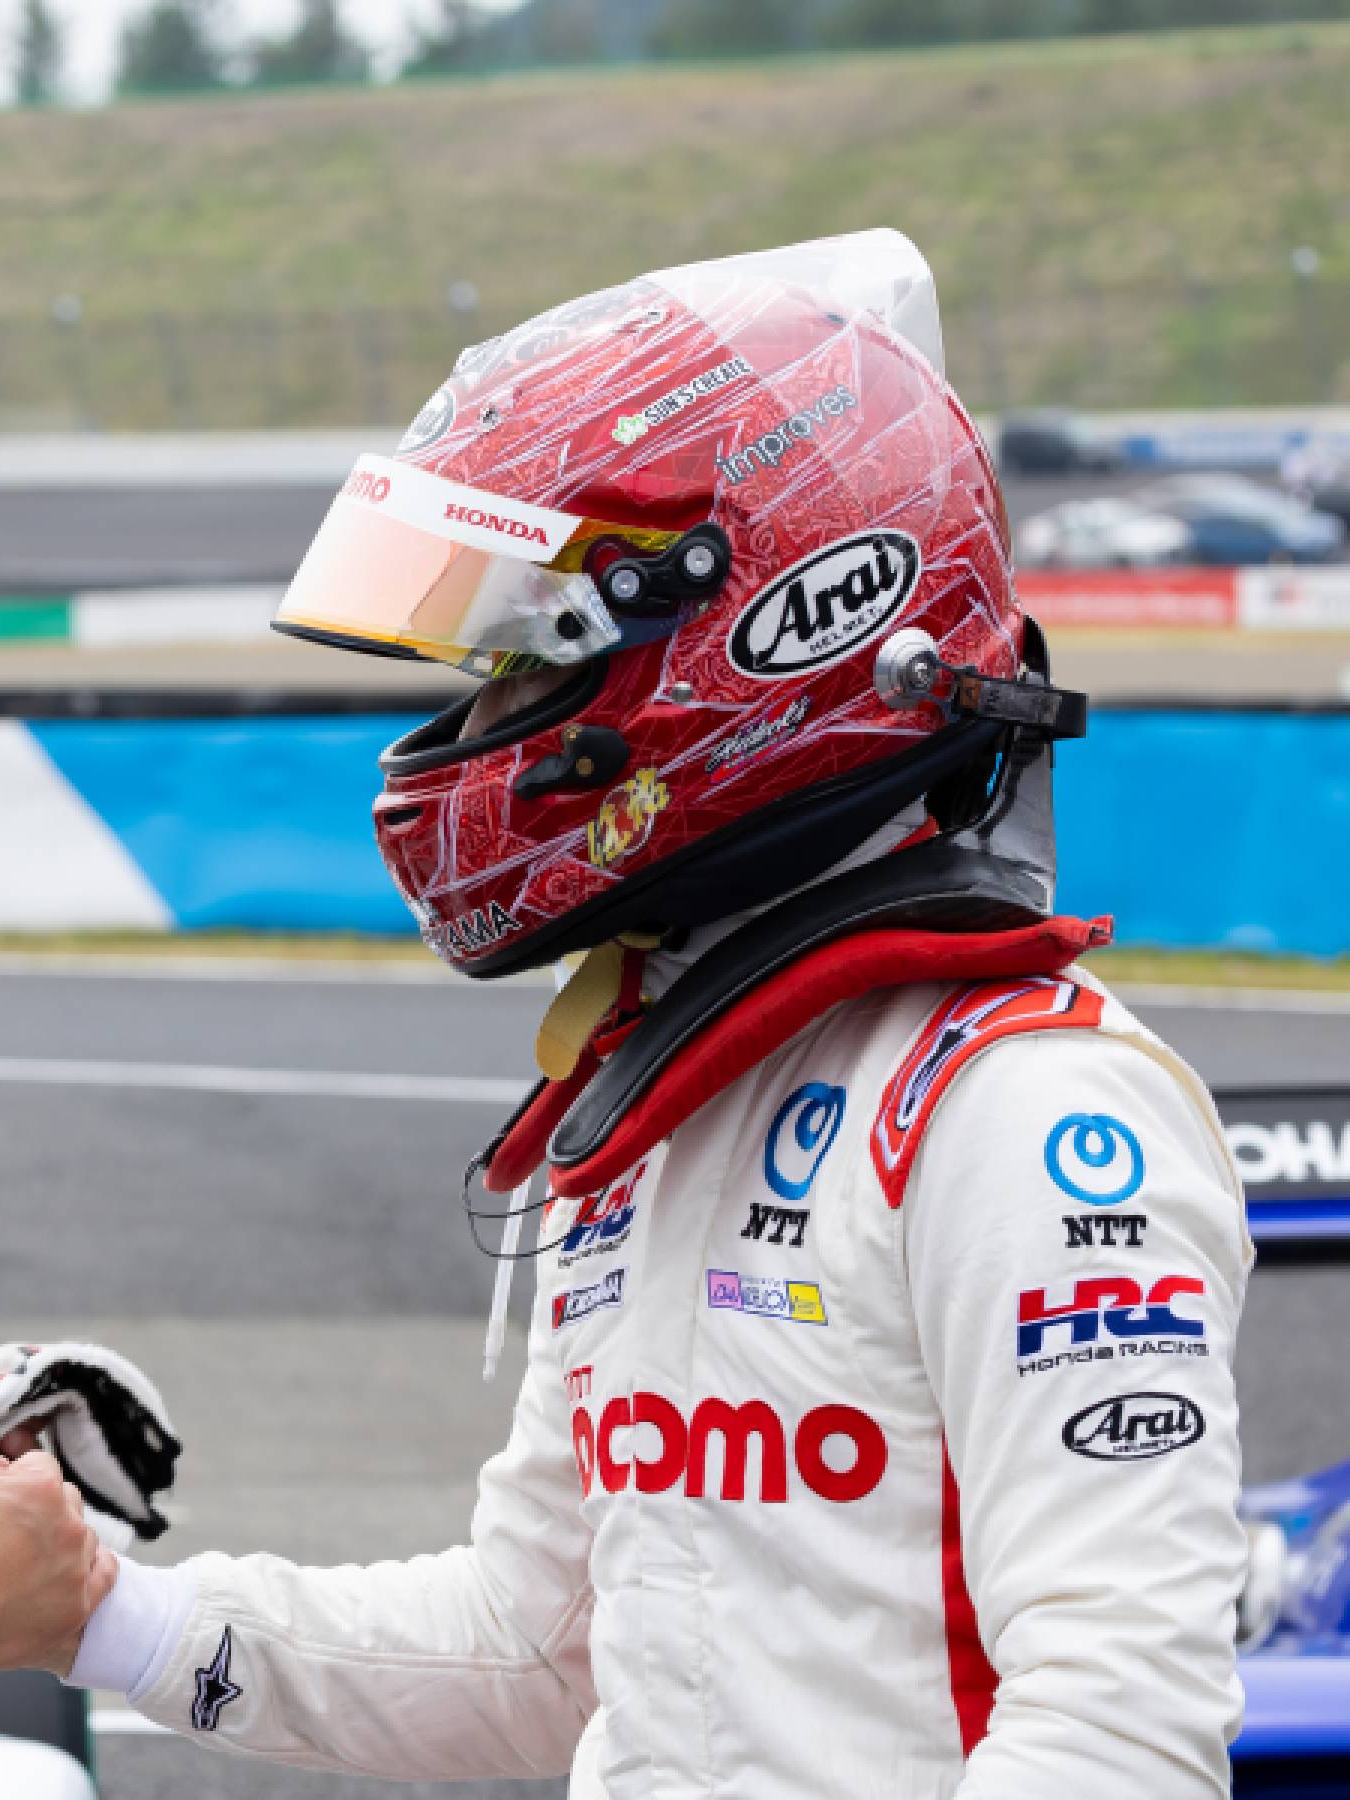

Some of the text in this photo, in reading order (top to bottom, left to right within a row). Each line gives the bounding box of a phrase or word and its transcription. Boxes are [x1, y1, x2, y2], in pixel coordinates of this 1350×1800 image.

[692, 354, 753, 394] CREATE
[715, 383, 858, 486] improves
[443, 502, 550, 547] HONDA
[752, 536, 898, 670] Arai
[1061, 1214, 1147, 1248] NTT
[1016, 1275, 1205, 1358] HRC
[1016, 1340, 1210, 1378] Honda RACING
[1074, 1399, 1193, 1447] Arai
